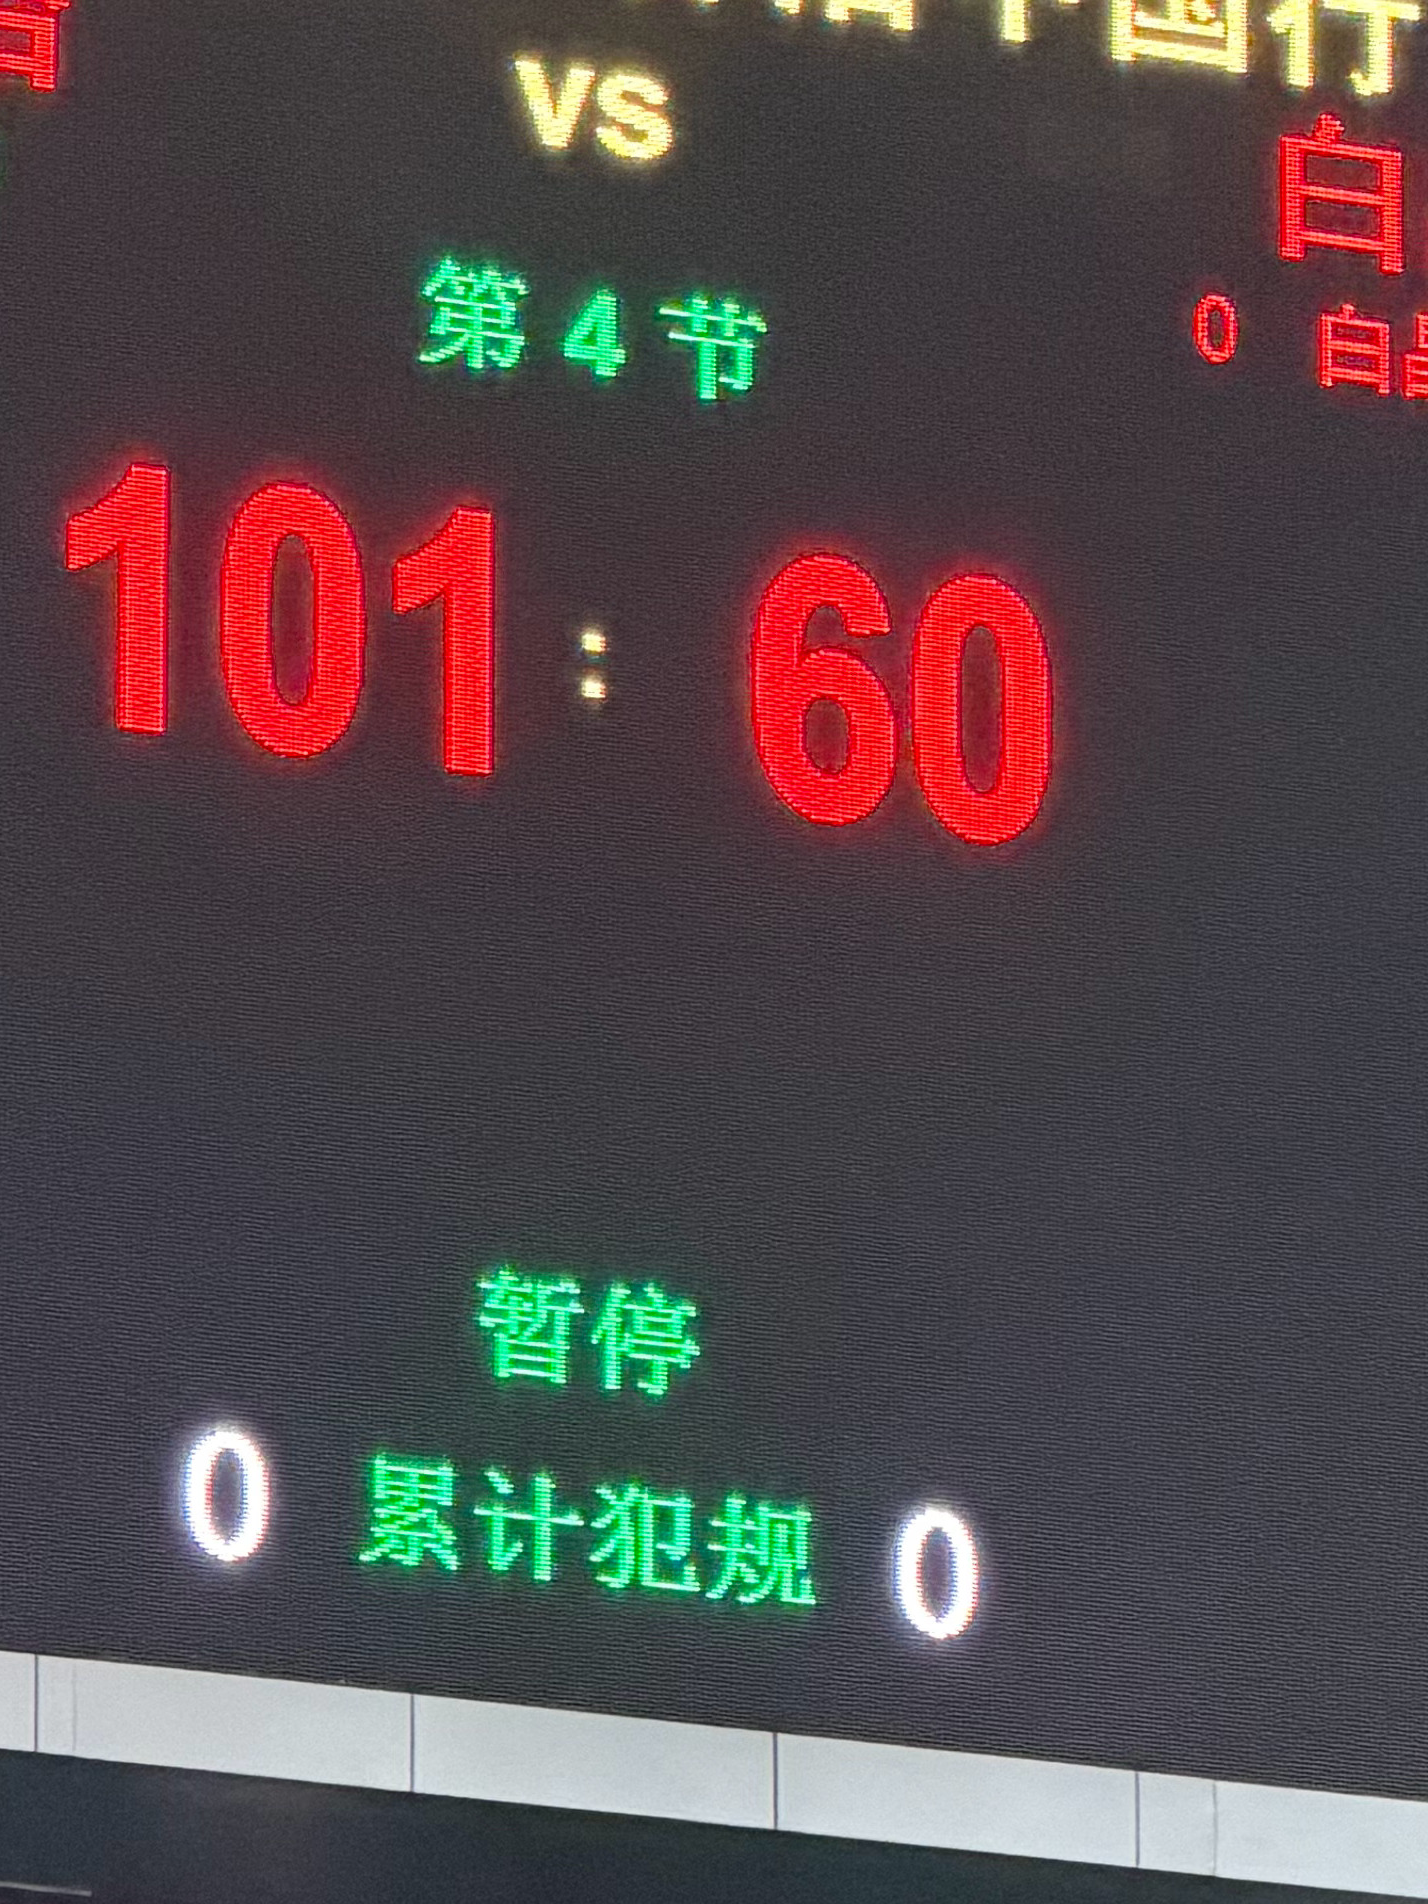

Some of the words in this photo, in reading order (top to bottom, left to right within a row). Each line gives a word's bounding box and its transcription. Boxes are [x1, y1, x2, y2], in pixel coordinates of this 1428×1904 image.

[418, 254, 529, 372] 第
[562, 288, 627, 380] 4
[658, 293, 769, 402] 节
[1191, 294, 1239, 365] 0
[64, 462, 495, 776] 101
[581, 629, 606, 701] :
[748, 552, 1054, 846] 60
[472, 1263, 701, 1398] 暂停
[183, 1426, 271, 1564] 0
[358, 1451, 818, 1607] 累计犯规
[893, 1503, 980, 1641] 0
